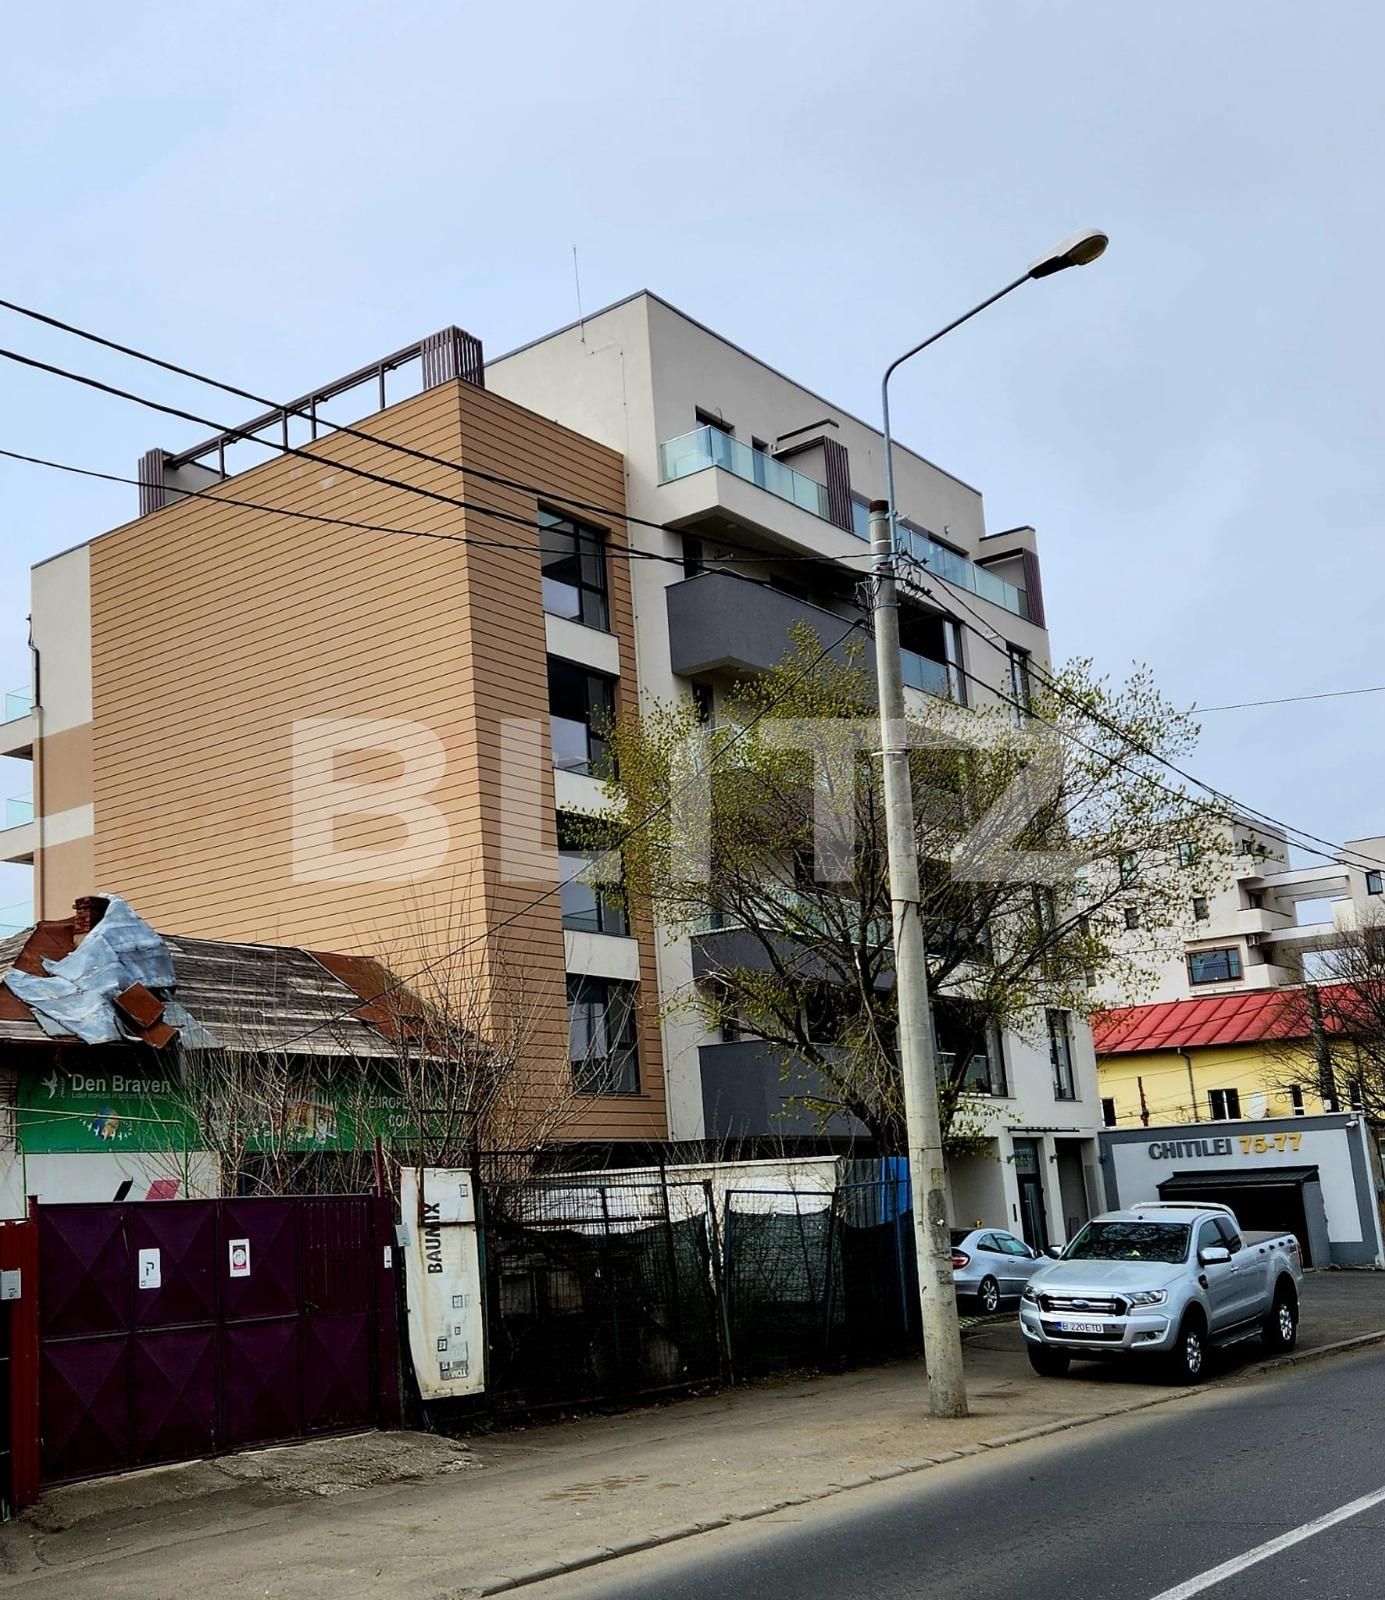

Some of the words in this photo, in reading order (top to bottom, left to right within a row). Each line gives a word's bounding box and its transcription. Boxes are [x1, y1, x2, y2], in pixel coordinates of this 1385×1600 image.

[72, 1074, 106, 1091] Den
[112, 1075, 170, 1093] Braven
[1149, 1138, 1234, 1160] CHITILEI
[1238, 1134, 1302, 1155] 75-77
[424, 1202, 443, 1274] BAUMIX
